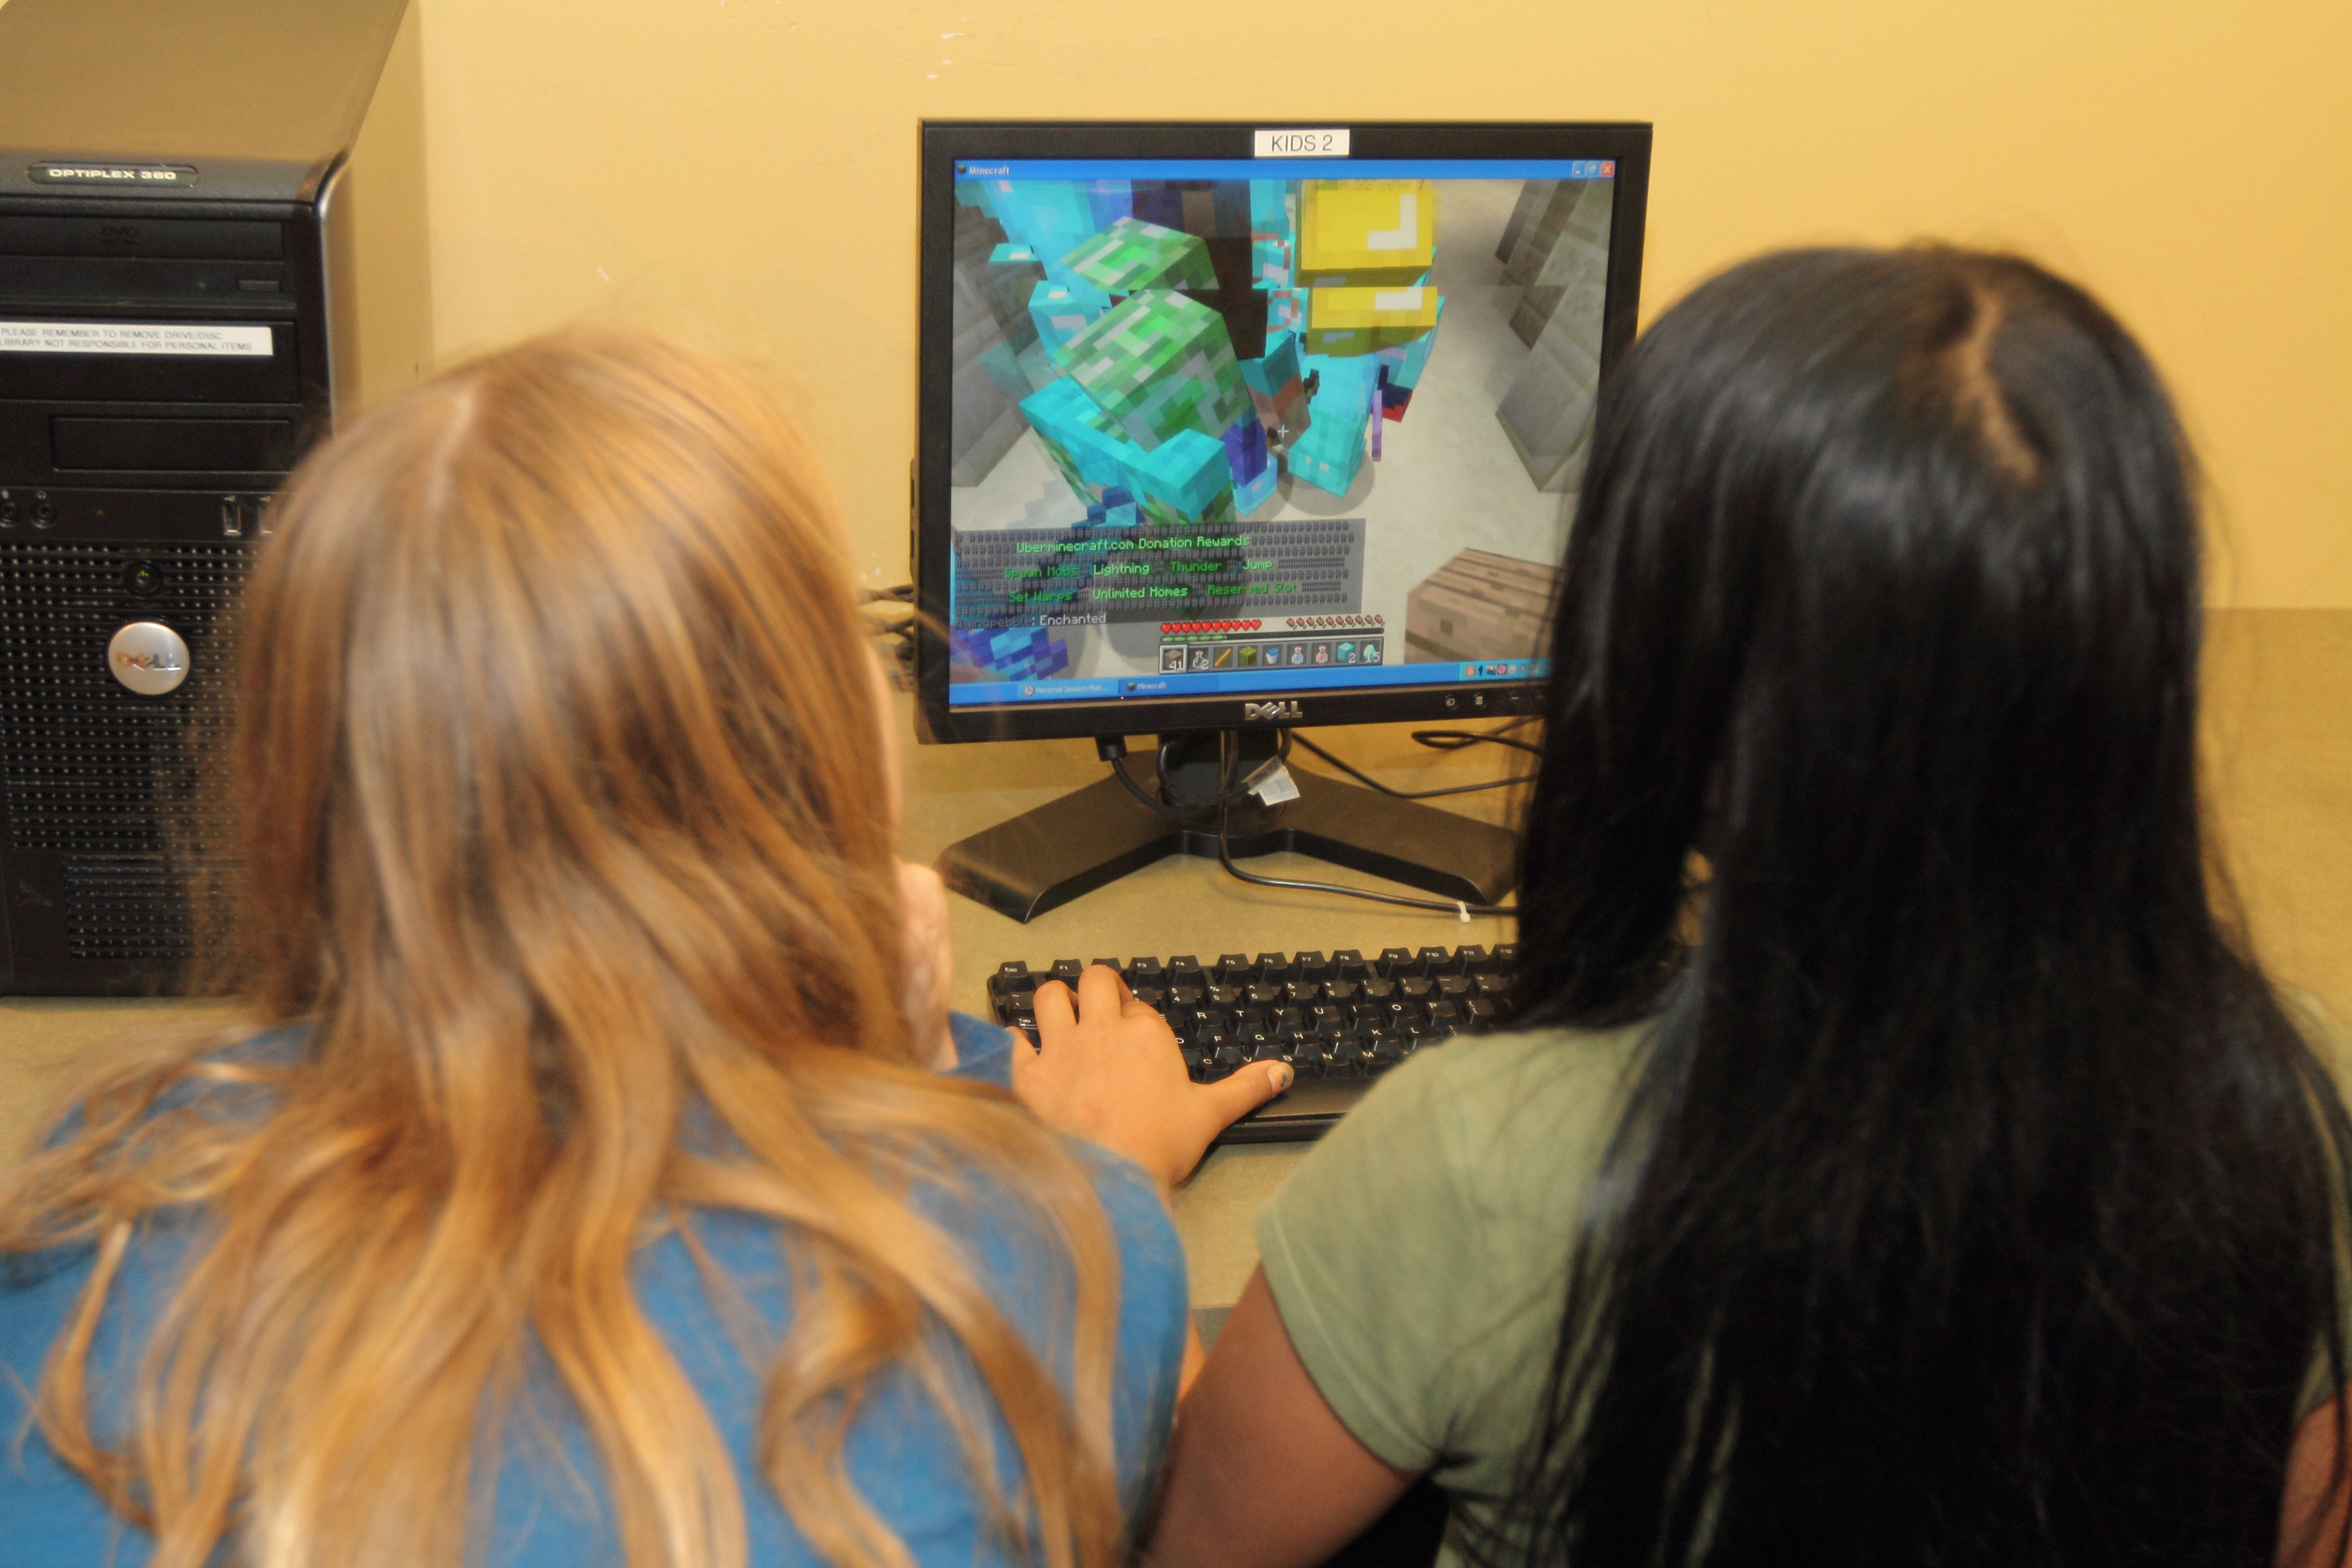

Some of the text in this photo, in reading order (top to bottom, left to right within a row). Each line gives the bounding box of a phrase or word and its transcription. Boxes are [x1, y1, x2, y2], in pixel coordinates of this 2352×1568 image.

[1272, 134, 1333, 152] KIDS 2
[48, 168, 177, 180] OPTIPLEX 360
[969, 166, 1009, 175] Minecraft
[1, 327, 38, 336] PLEASE
[165, 332, 222, 340] DRIVE/DISC
[69, 339, 137, 348] RESPONSIBLE
[1016, 535, 1250, 554] Uberminecraft.com Donation Rewards
[1004, 560, 1273, 580] Spawn Mobs Lightning Thunder Jump
[1008, 583, 1297, 603] Set Warps Unlimited Homes Reserved Slot
[1039, 613, 1107, 626] Enchanted
[1348, 654, 1356, 664] 2
[1367, 652, 1380, 663] 15
[1201, 659, 1209, 670] 2
[1036, 685, 1063, 694] Personal
[1245, 701, 1302, 721] DELL
